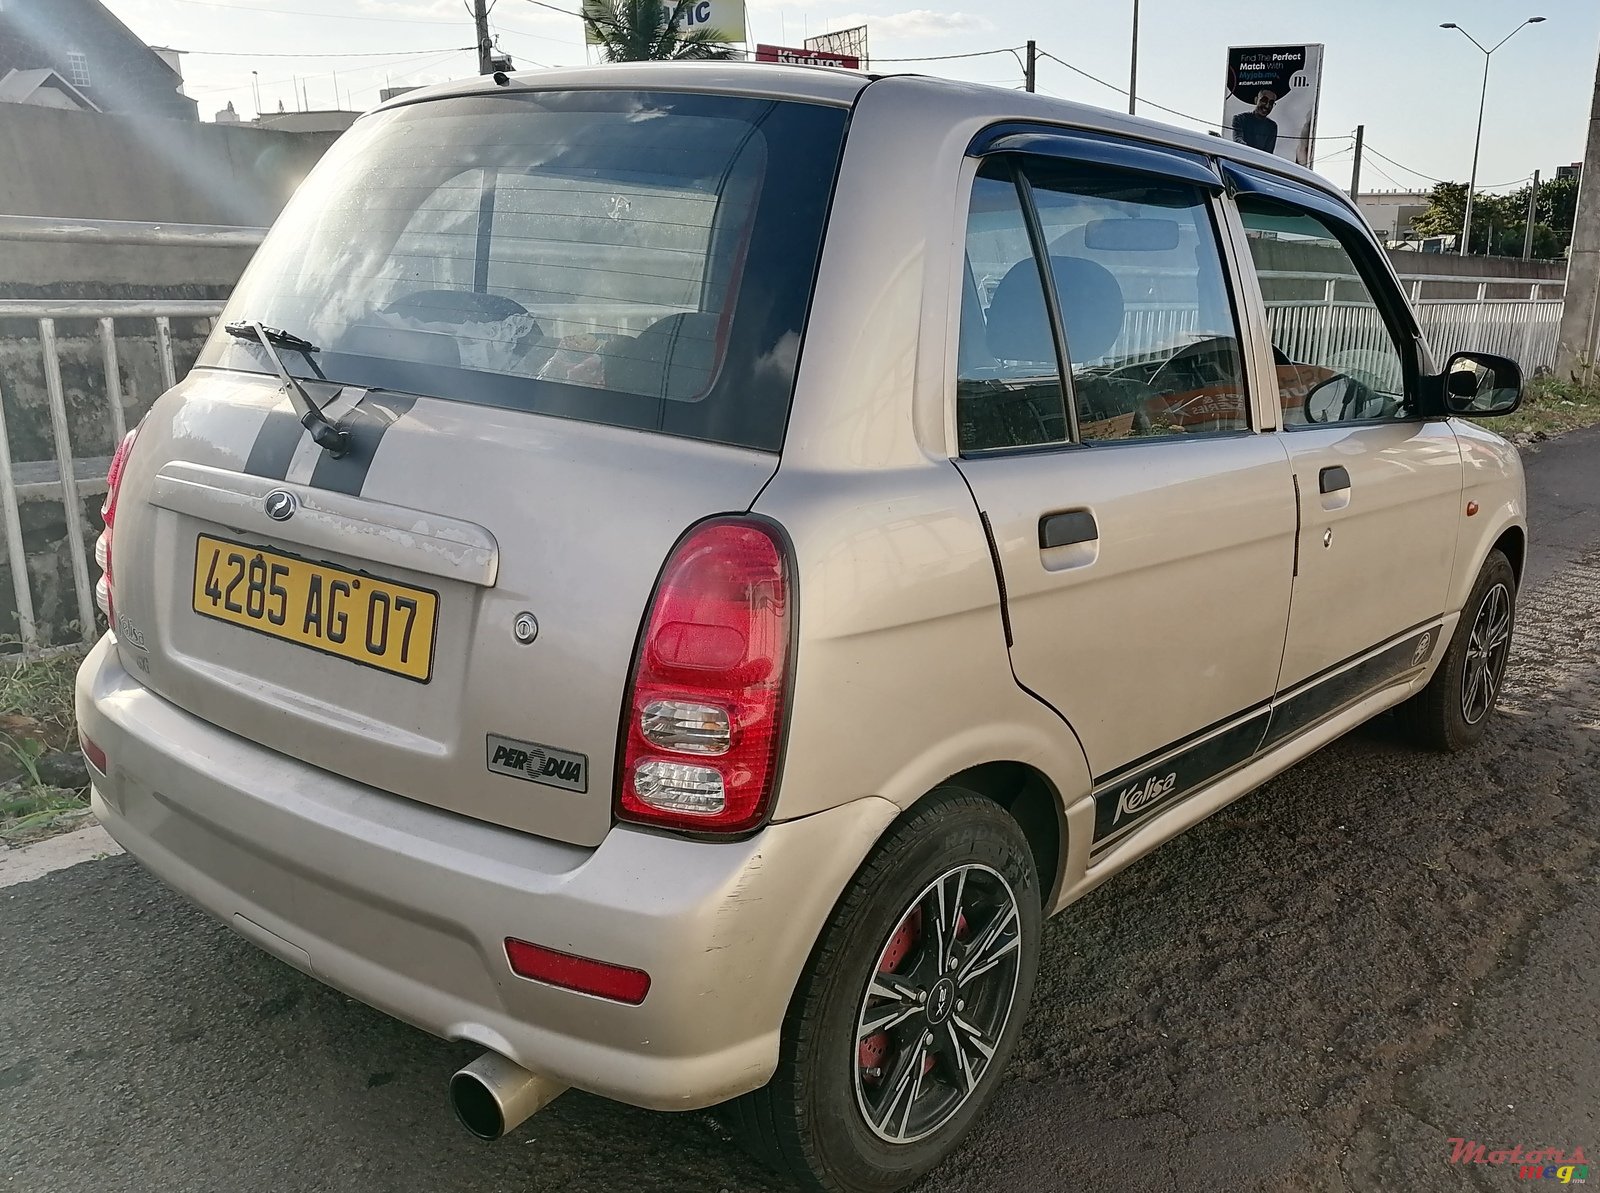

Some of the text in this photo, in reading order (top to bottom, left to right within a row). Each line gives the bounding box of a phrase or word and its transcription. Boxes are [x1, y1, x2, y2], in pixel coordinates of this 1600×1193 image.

[1240, 62, 1265, 70] Match
[1272, 53, 1301, 61] Perfect
[204, 548, 418, 663] 4285 AG 07
[491, 745, 582, 782] PERODUA
[1112, 772, 1177, 826] Kelisa
